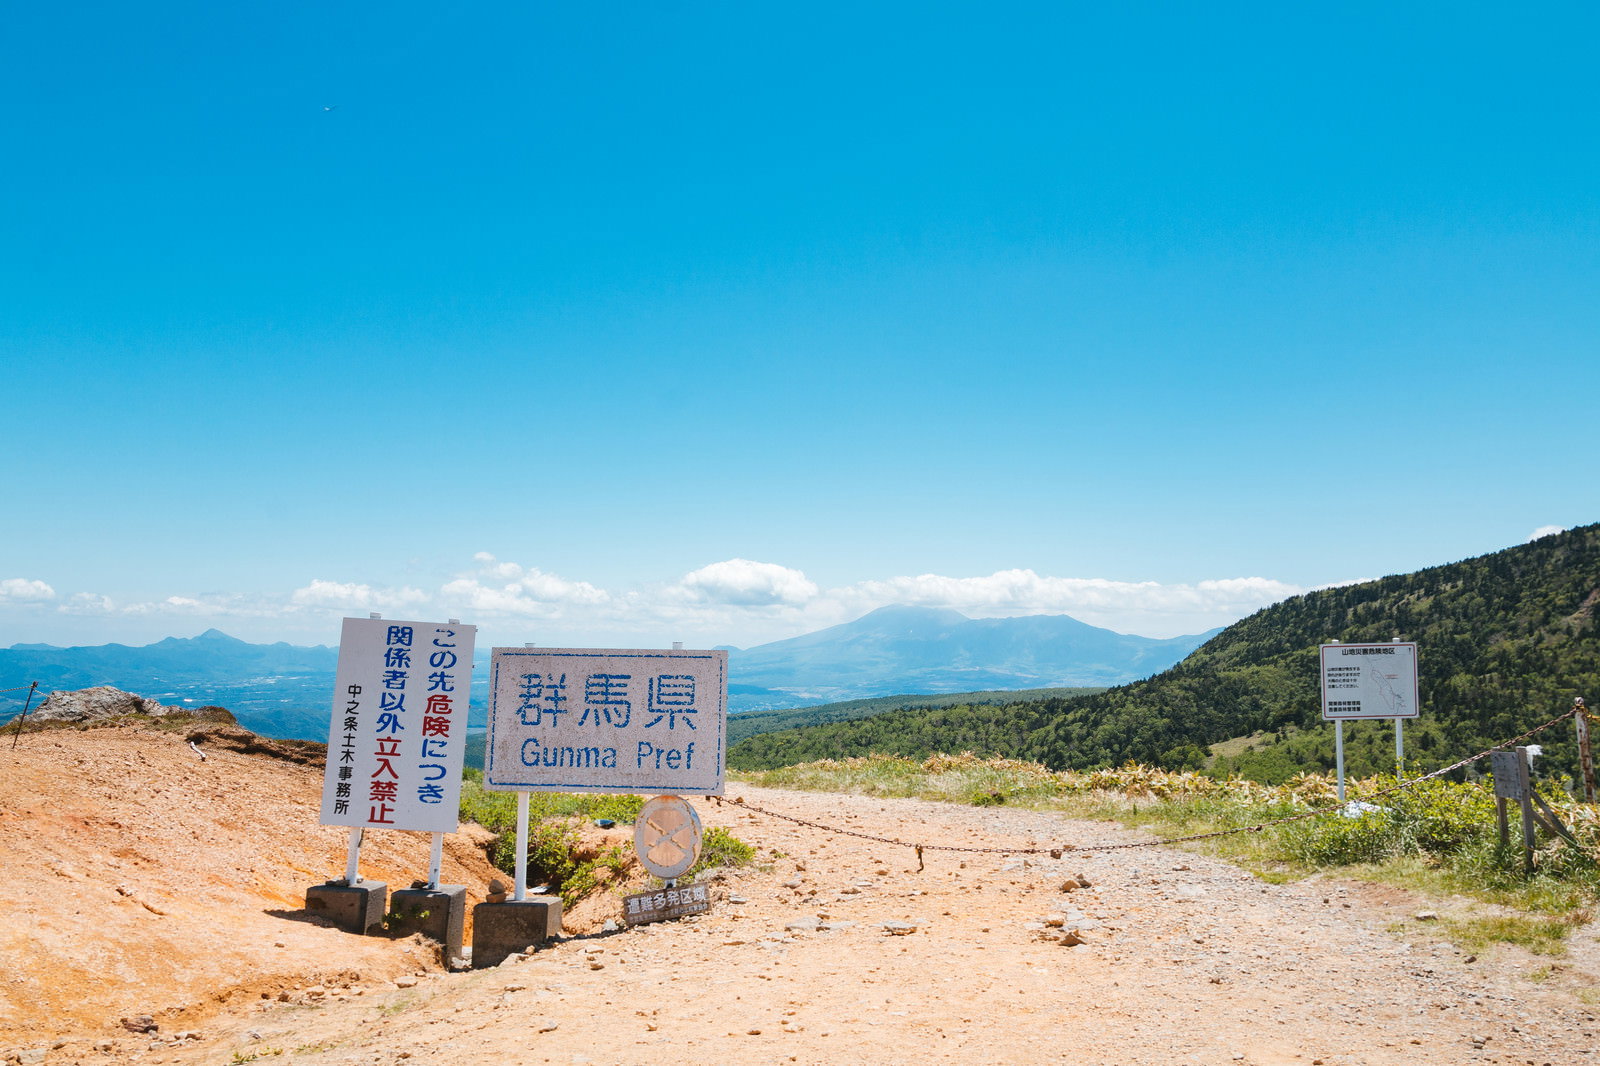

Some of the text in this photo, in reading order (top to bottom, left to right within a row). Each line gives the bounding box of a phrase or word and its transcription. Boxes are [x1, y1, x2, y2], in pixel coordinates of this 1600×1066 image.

[334, 684, 362, 815] 中之条土木事務所
[368, 625, 413, 825] 関係者以外立入禁止
[417, 629, 457, 804] この先危険につき
[516, 673, 698, 730] 群馬県
[521, 737, 695, 769] Gunma Pref
